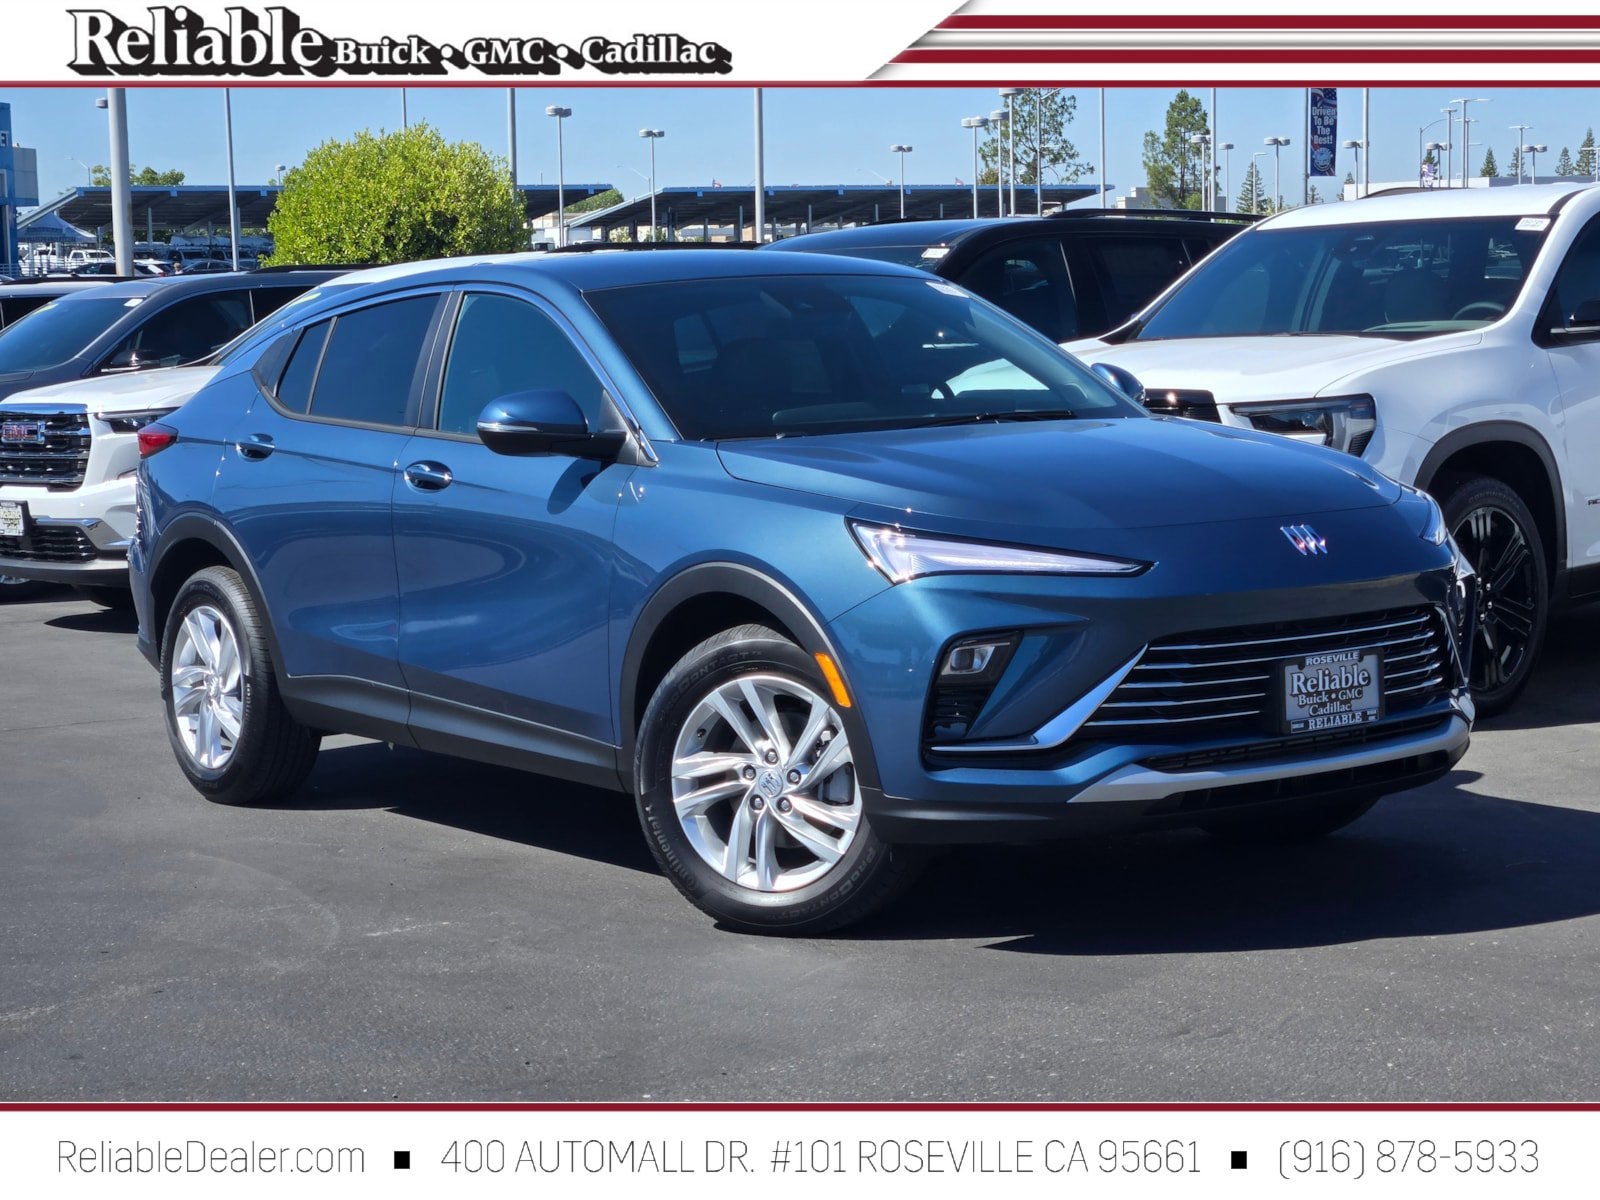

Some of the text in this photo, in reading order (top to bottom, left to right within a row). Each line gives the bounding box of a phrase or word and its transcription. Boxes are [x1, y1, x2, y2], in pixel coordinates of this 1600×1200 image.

[1312, 107, 1336, 116] Driven
[1314, 116, 1334, 125] To Be
[1317, 126, 1330, 135] The
[2, 424, 38, 439] GMC
[1306, 652, 1359, 665] ROSEVILLE
[1291, 664, 1369, 695] Reliable
[1297, 687, 1363, 706] Buick GMC
[1309, 701, 1352, 716] Cadillac
[1309, 712, 1362, 730] RELIABLE
